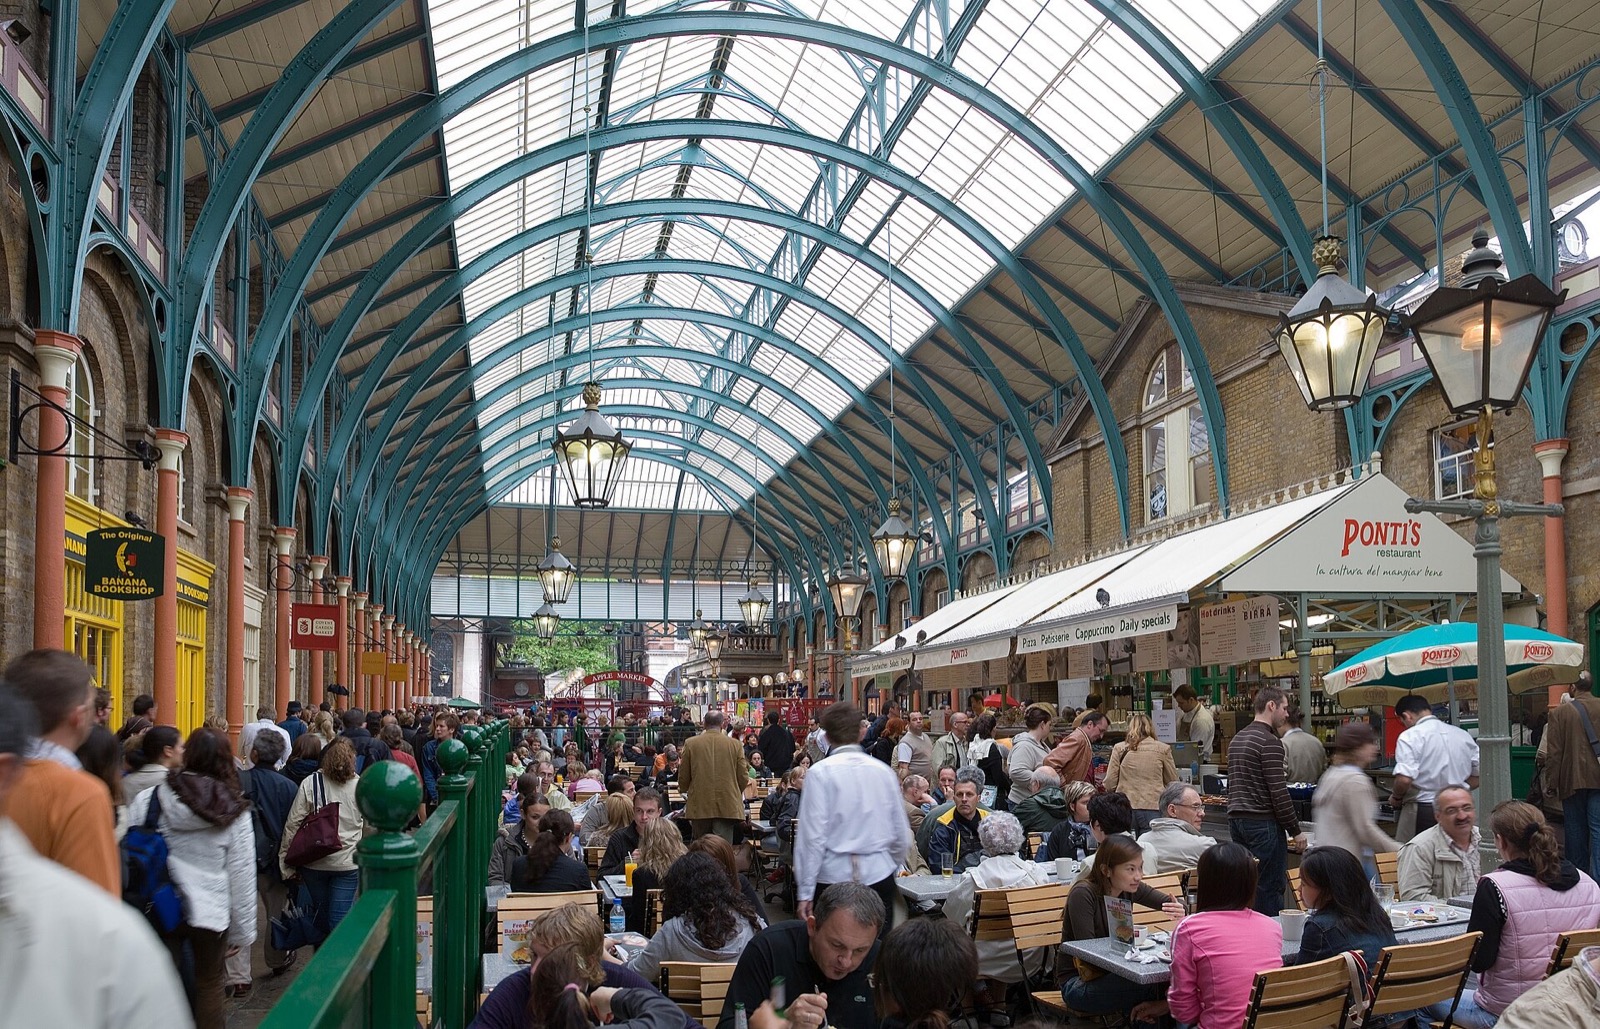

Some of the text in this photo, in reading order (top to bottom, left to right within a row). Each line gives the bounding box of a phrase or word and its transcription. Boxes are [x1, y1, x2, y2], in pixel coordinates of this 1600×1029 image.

[99, 531, 153, 543] The Original
[1341, 518, 1422, 557] PONTI'S
[1376, 549, 1422, 558] restaurant
[1315, 563, 1443, 582] la cultura del mangiar bene
[101, 577, 147, 587] BANANA
[94, 585, 155, 595] BOOKSHOP
[184, 584, 209, 603] BOOKSHOP
[1200, 605, 1236, 619] Hot drinks
[1243, 607, 1272, 621] BIRRA
[1022, 611, 1171, 649] Pizza Patisserie Cappuccino Daily specials
[1421, 648, 1461, 666] PONTI'S
[1523, 643, 1554, 660] PONTI'S
[591, 672, 648, 682] APPLE MARKET
[1345, 664, 1367, 684] PONTI'S
